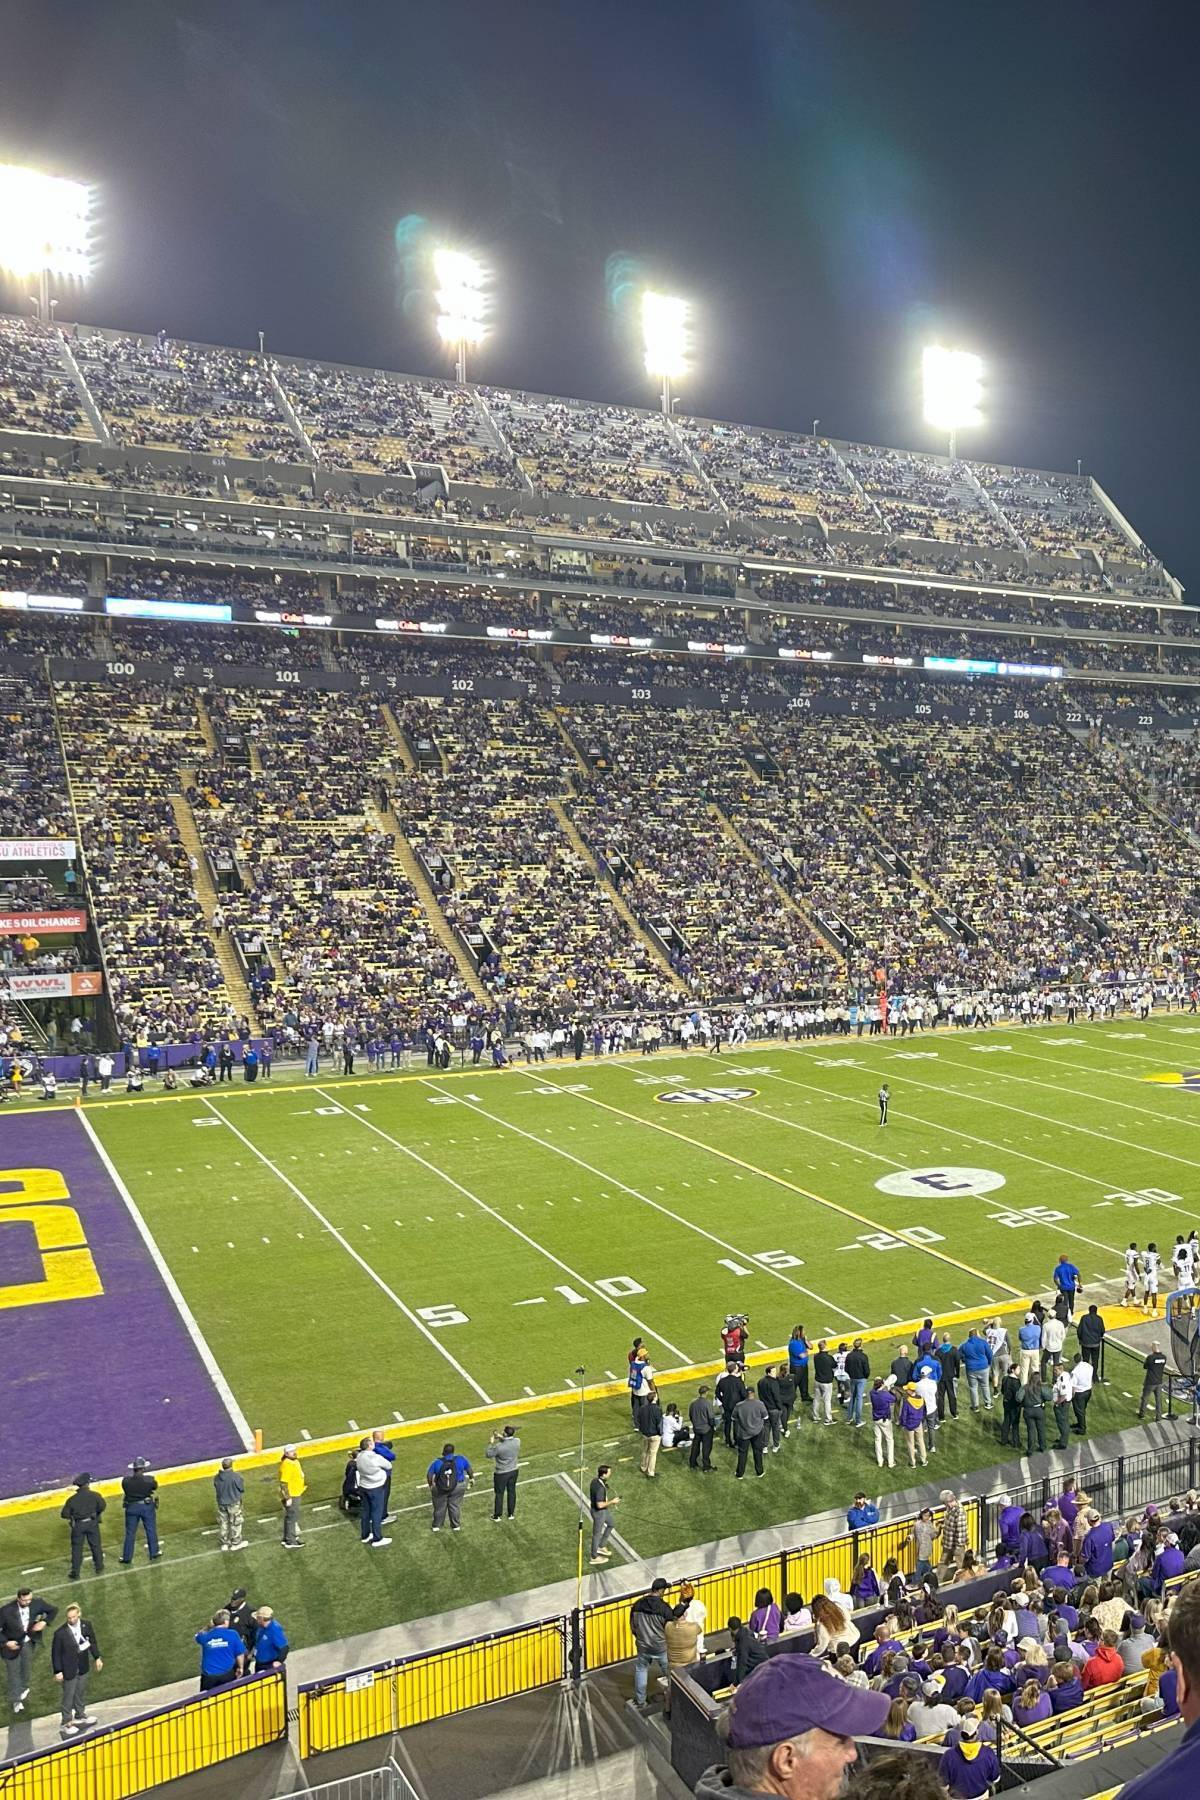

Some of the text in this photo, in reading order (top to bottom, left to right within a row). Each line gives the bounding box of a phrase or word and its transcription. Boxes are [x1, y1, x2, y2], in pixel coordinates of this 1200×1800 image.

[281, 613, 304, 623] Coke
[105, 662, 136, 675] 100
[275, 671, 301, 683] 101
[451, 679, 475, 691] 102
[631, 688, 652, 700] 103
[792, 697, 811, 708] 104
[914, 704, 932, 715] 105
[1013, 709, 1030, 720] 106
[1065, 712, 1082, 722] 222
[1137, 715, 1154, 725] 223
[13, 846, 66, 857] ATHLETICS
[21, 918, 38, 927] OIL
[38, 916, 81, 926] CHANGE
[1103, 1187, 1184, 1208] 30
[985, 1205, 1071, 1229] 25
[855, 1225, 946, 1251] 20
[717, 1249, 807, 1276] 15
[553, 1275, 647, 1305] 10
[415, 1303, 471, 1328] 5
